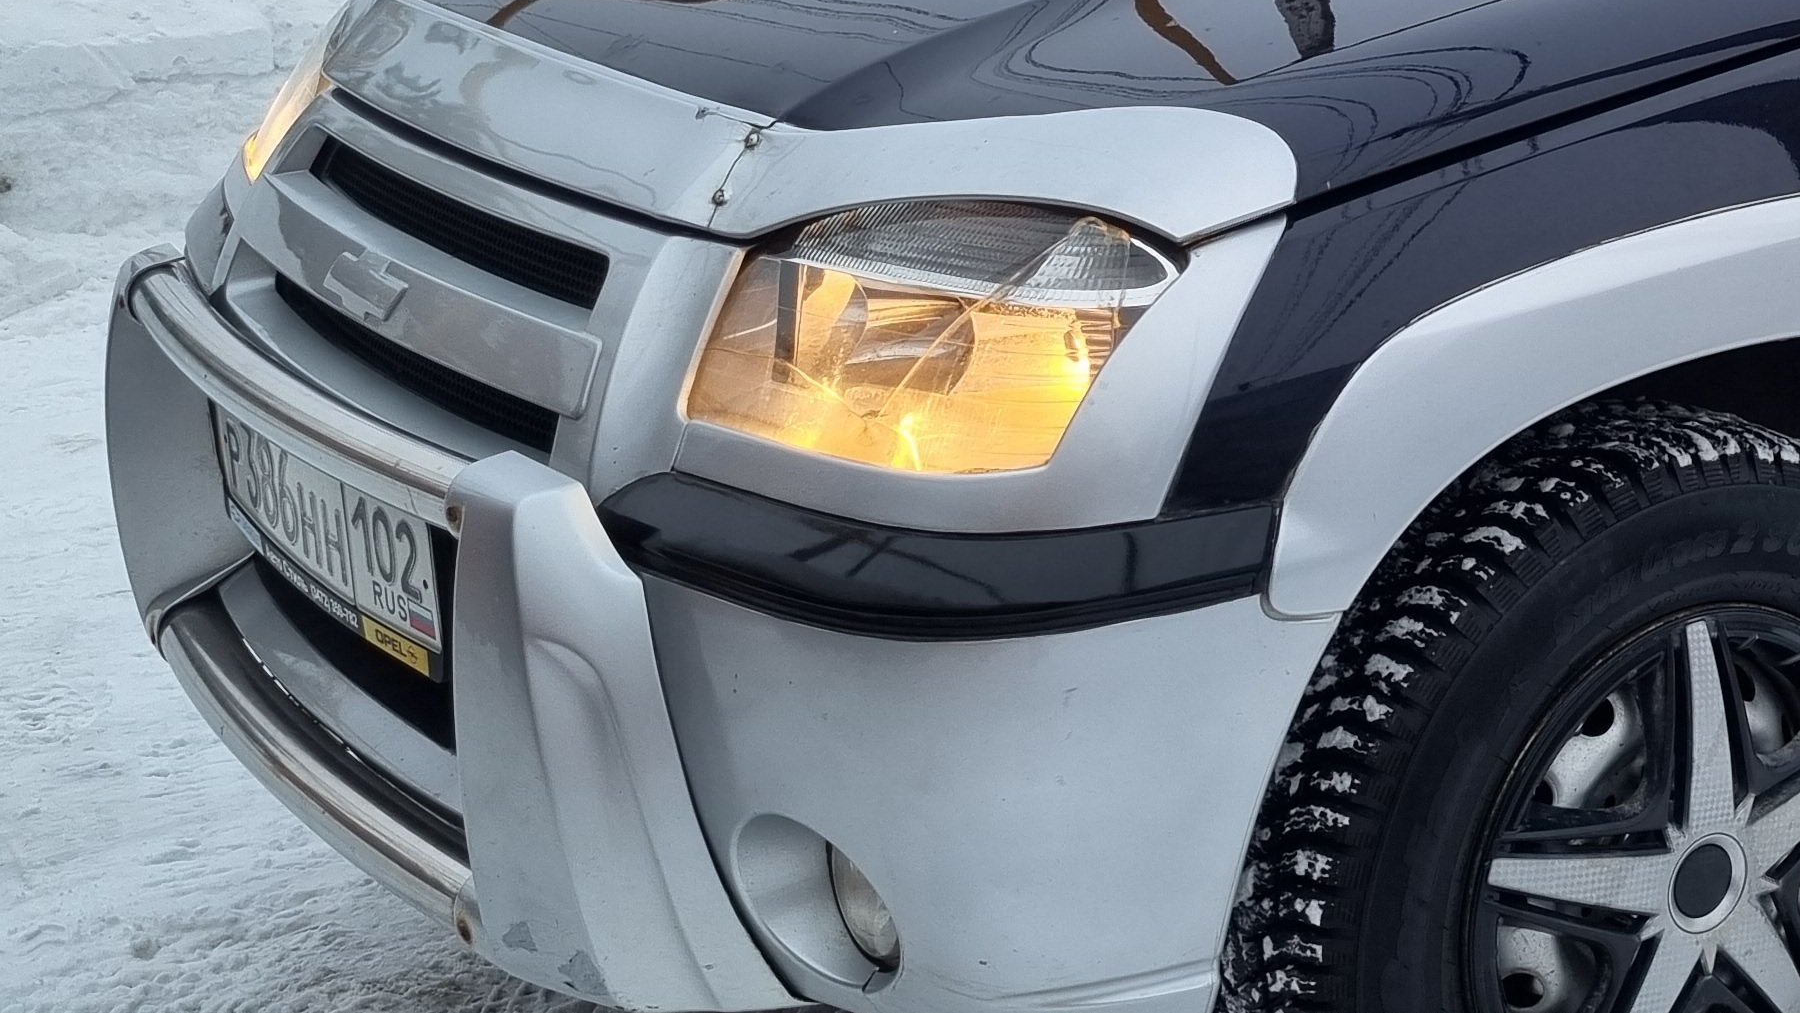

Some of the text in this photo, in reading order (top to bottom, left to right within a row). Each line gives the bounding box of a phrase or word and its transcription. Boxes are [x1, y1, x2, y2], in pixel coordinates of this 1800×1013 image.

[351, 496, 423, 604] 102
[372, 580, 409, 623] RUS
[375, 630, 408, 658] OPEL
